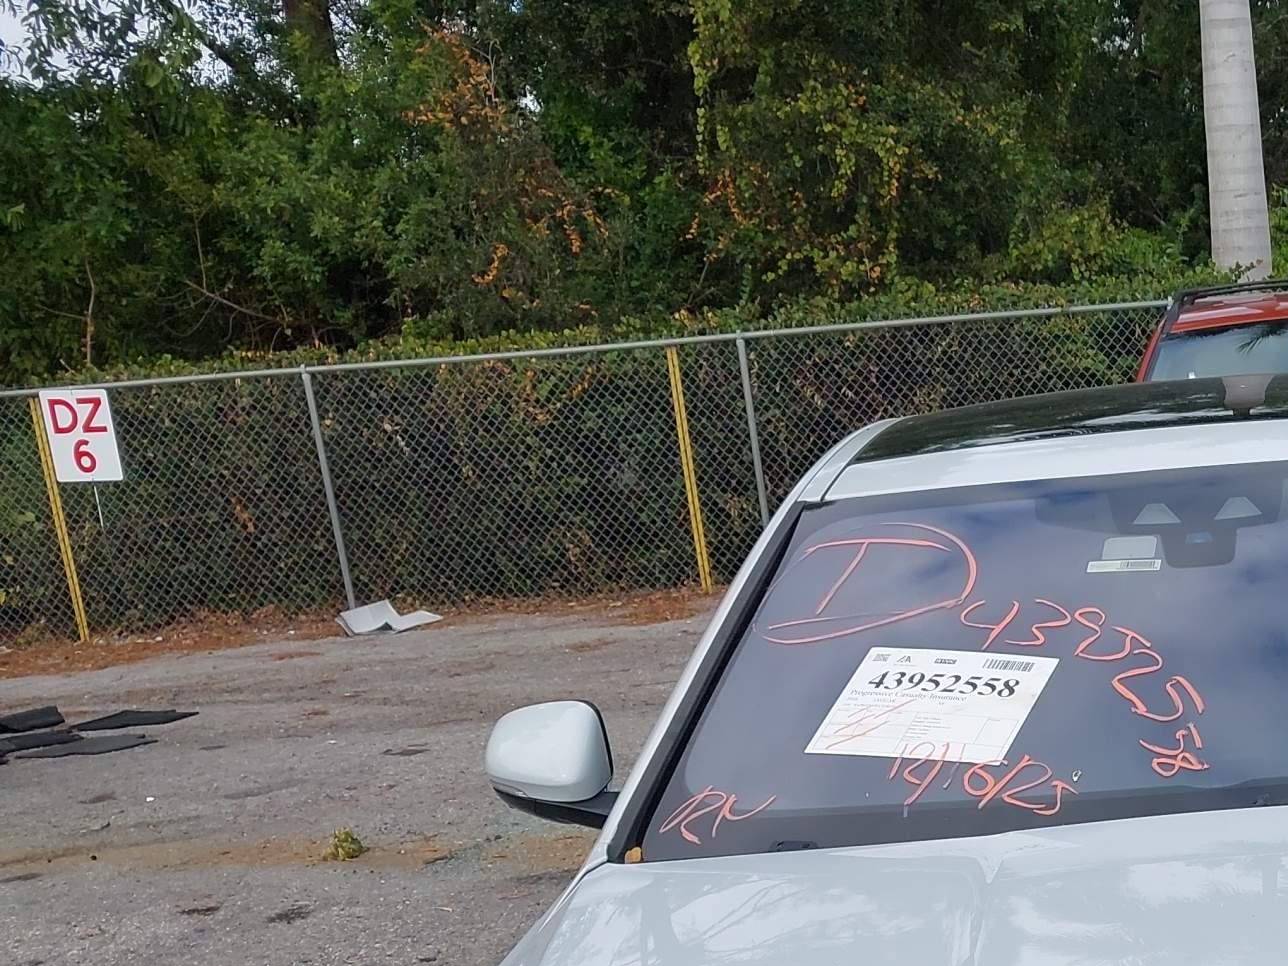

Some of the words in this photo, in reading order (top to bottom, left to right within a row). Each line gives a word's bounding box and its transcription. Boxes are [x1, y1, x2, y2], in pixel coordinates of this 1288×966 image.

[47, 397, 108, 434] DZ
[73, 439, 97, 473] 6
[868, 670, 1020, 698] 43952558
